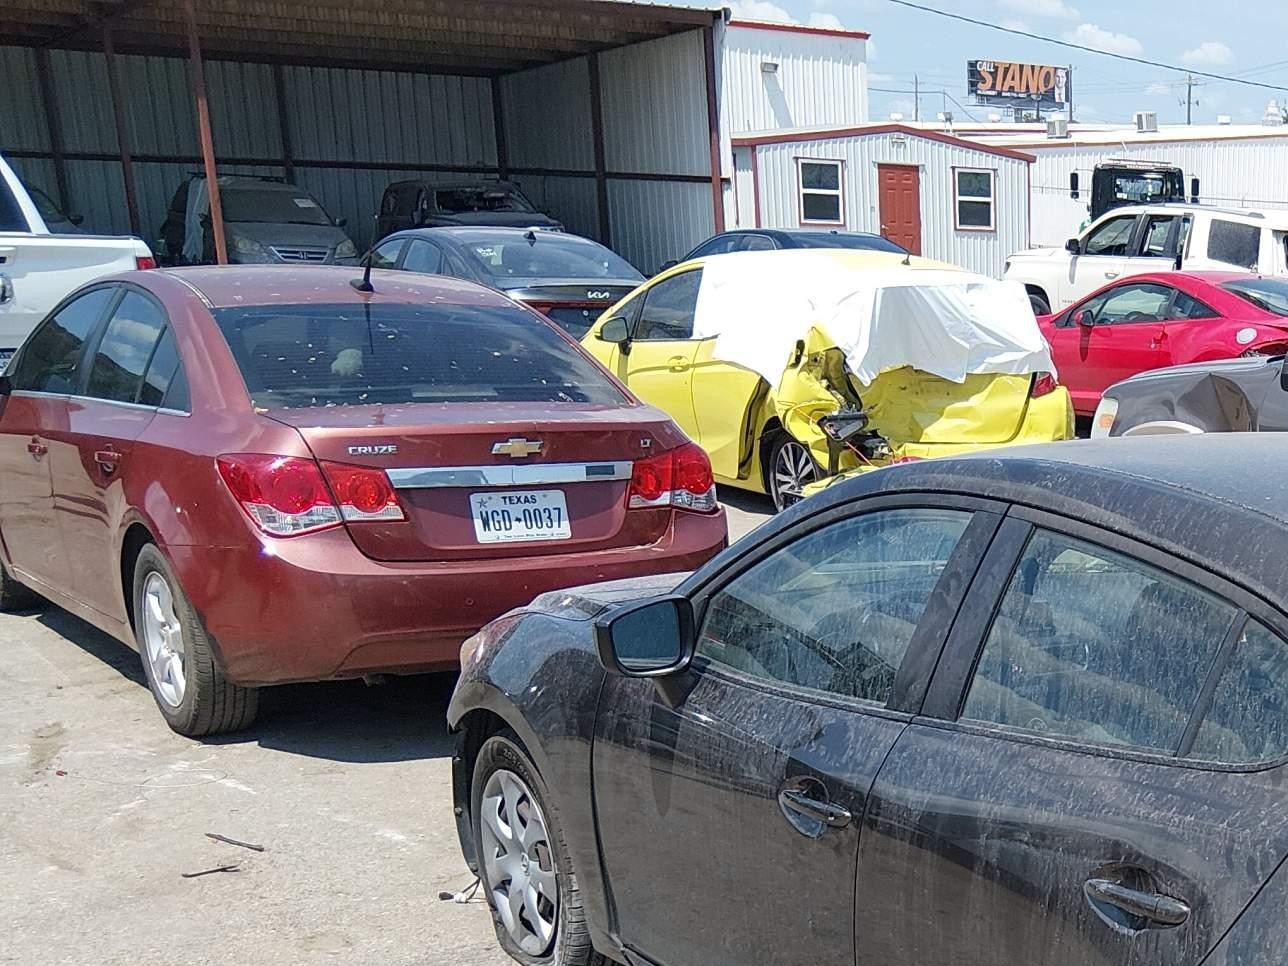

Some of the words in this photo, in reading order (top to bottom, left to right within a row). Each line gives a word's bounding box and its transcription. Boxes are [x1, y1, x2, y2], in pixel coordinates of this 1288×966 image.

[976, 61, 995, 72] CALL
[348, 445, 398, 455] CRUZE
[501, 494, 537, 505] TEXAS
